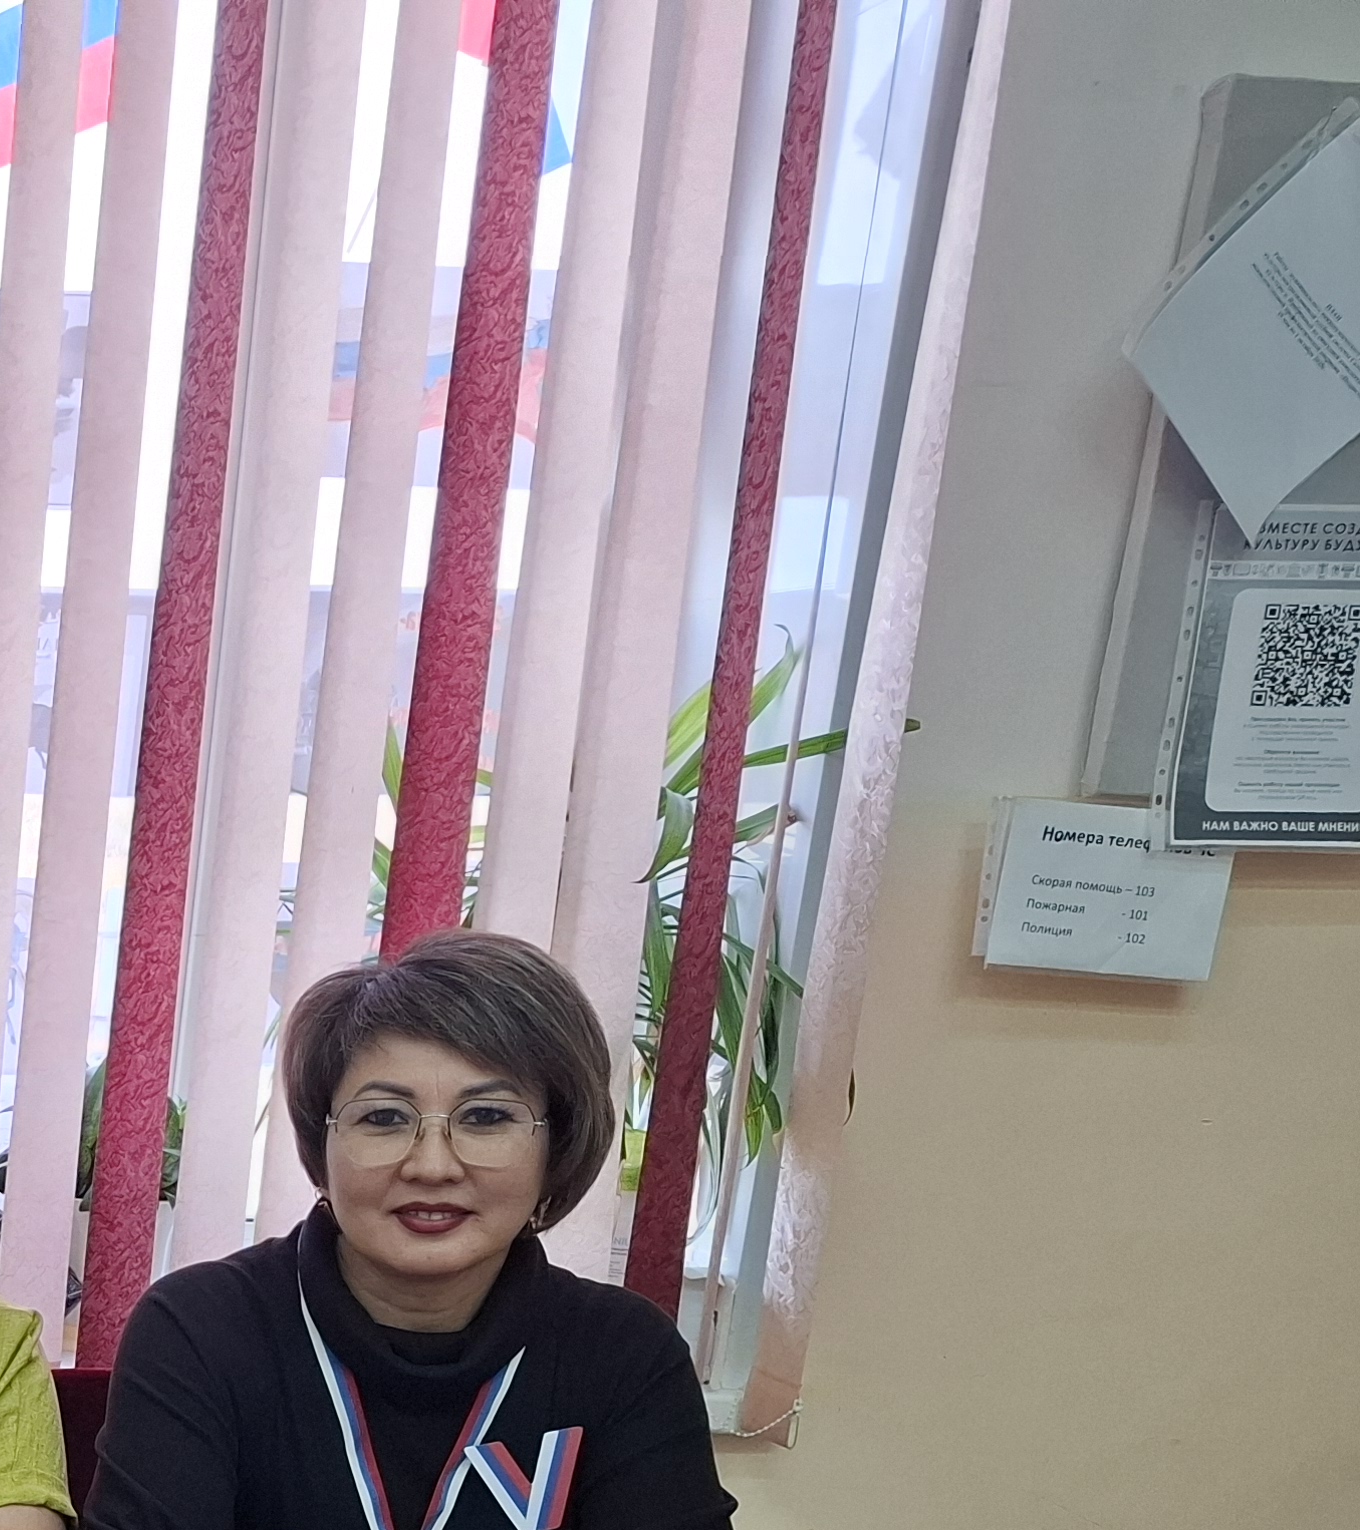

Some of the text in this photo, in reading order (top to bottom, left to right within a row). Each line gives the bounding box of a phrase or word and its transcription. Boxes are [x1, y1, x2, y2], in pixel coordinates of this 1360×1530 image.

[1042, 825, 1104, 847] Номера
[1202, 821, 1230, 831] НАМ
[1233, 821, 1278, 832] ВАЖНО
[1281, 821, 1315, 832] ВАШЕ
[1031, 874, 1073, 889] Скорая
[1075, 879, 1123, 894] помощь
[1135, 885, 1155, 897] 103
[1026, 898, 1085, 914] Пожарная
[1129, 909, 1148, 921] 101
[1021, 921, 1073, 937] Полиция
[1125, 933, 1146, 945] 102
